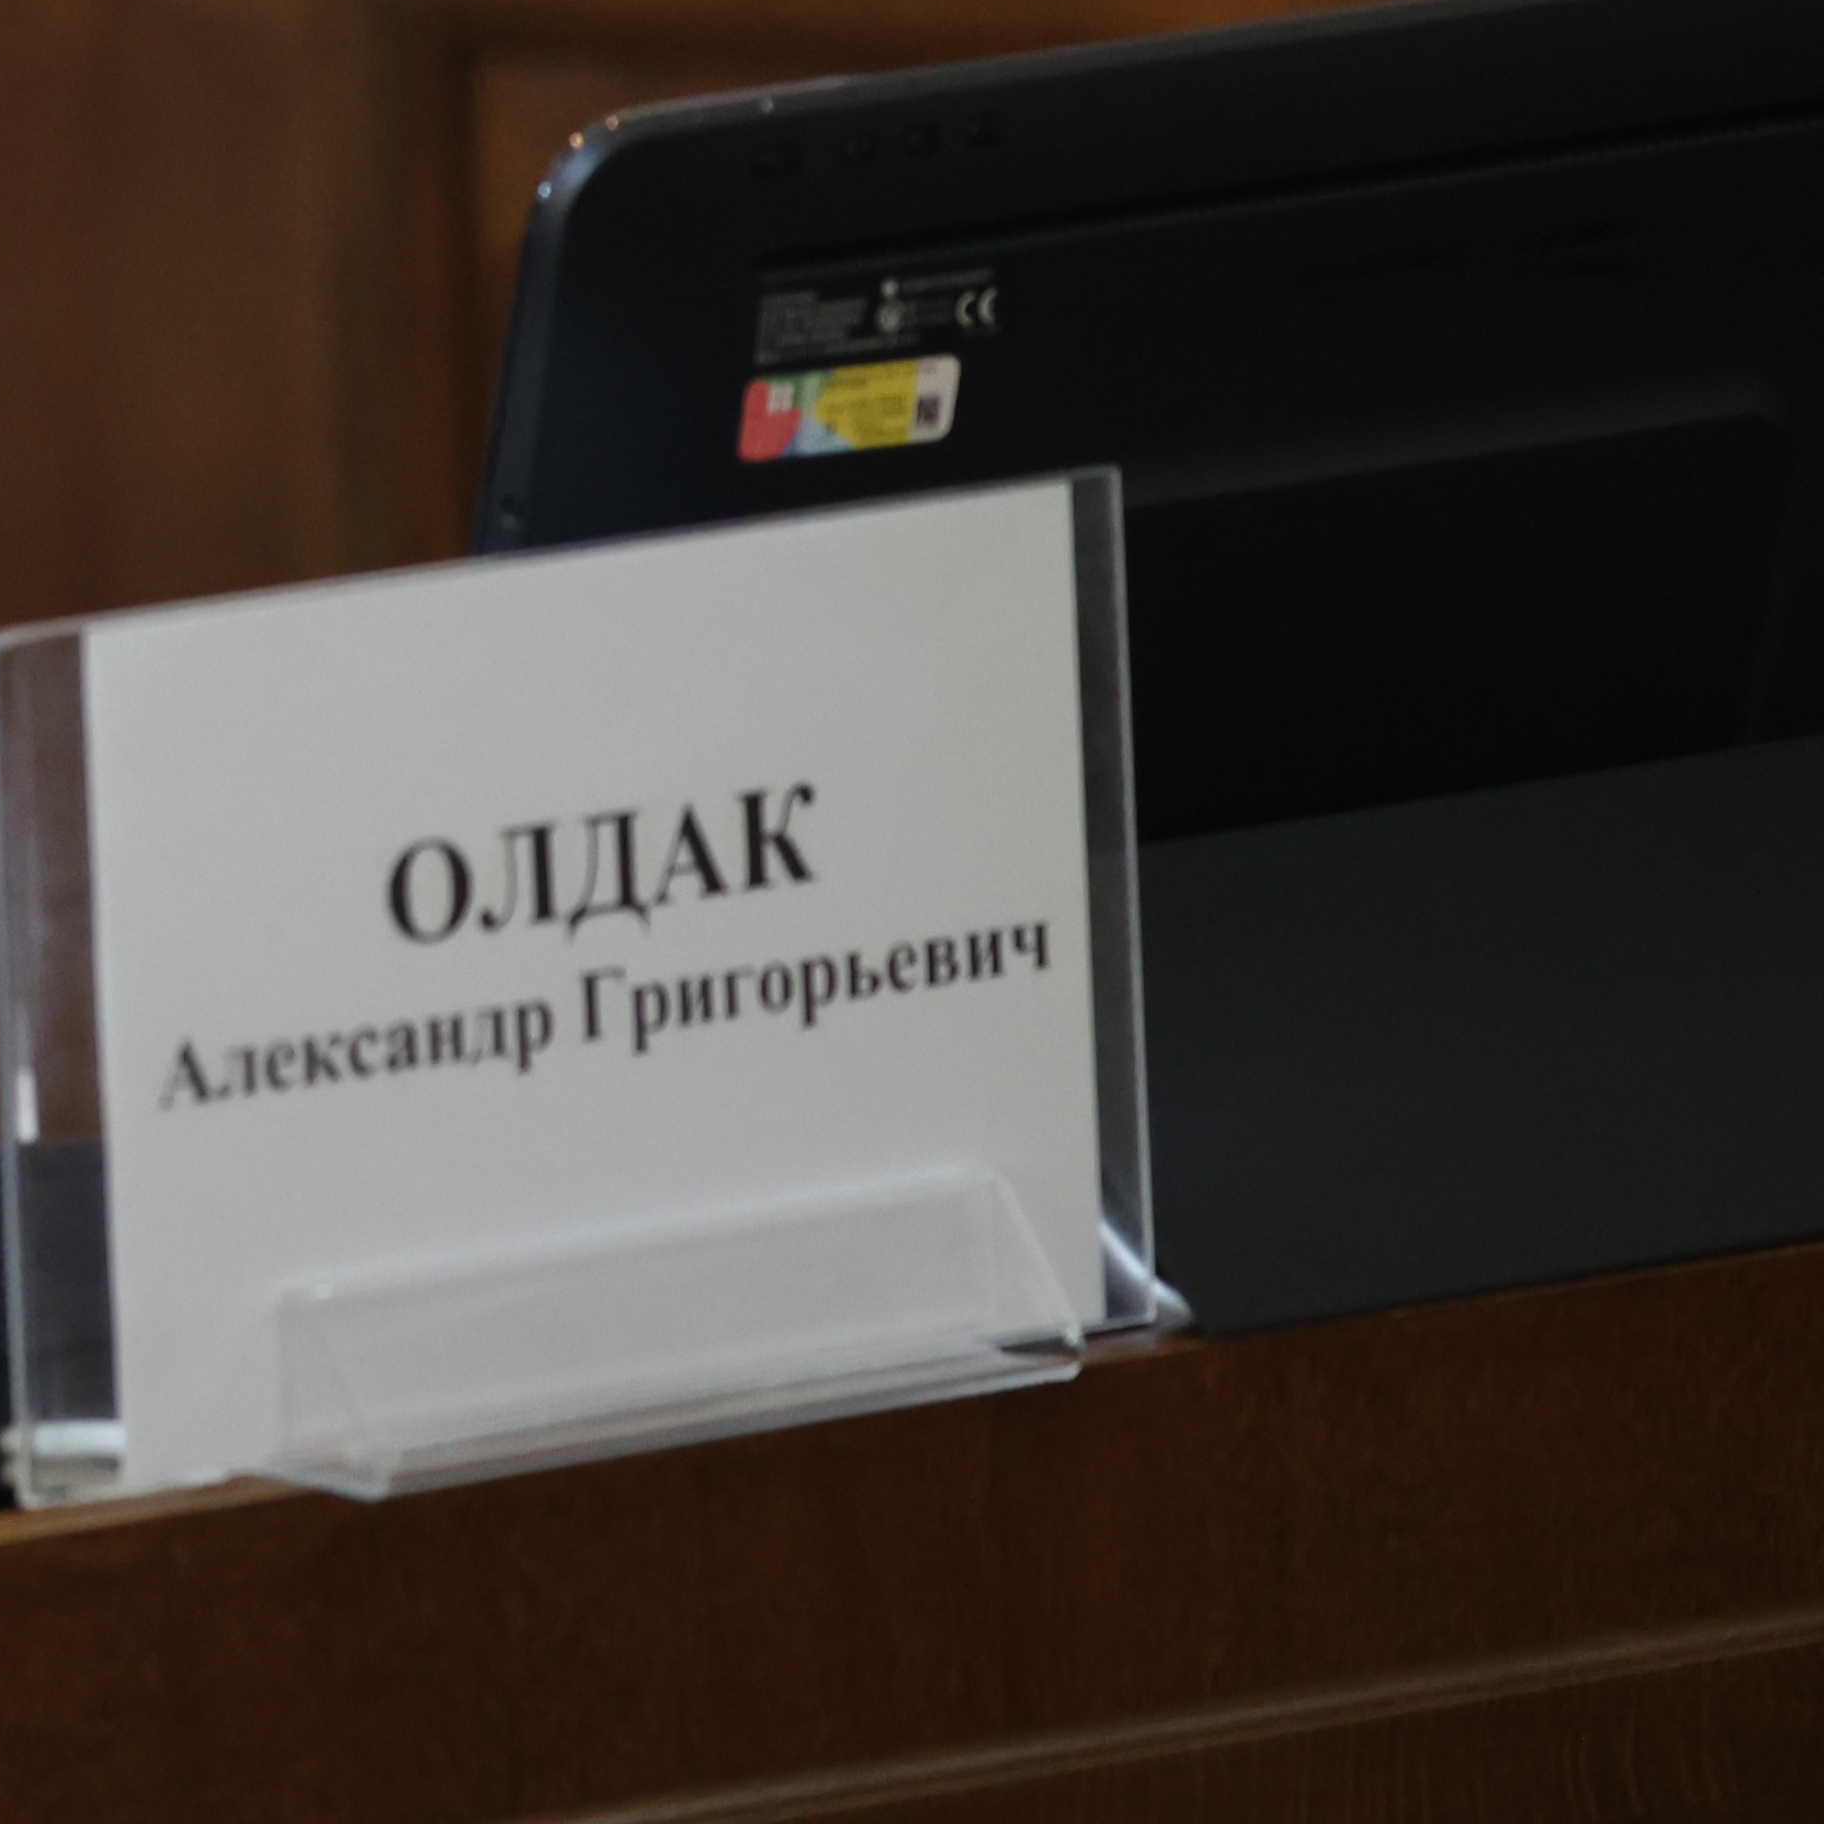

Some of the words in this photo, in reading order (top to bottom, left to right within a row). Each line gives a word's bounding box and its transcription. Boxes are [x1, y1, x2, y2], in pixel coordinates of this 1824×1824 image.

[385, 782, 817, 943] ОЛДАК
[157, 1000, 554, 1106] Александр
[578, 920, 1051, 1056] Григорьевич
